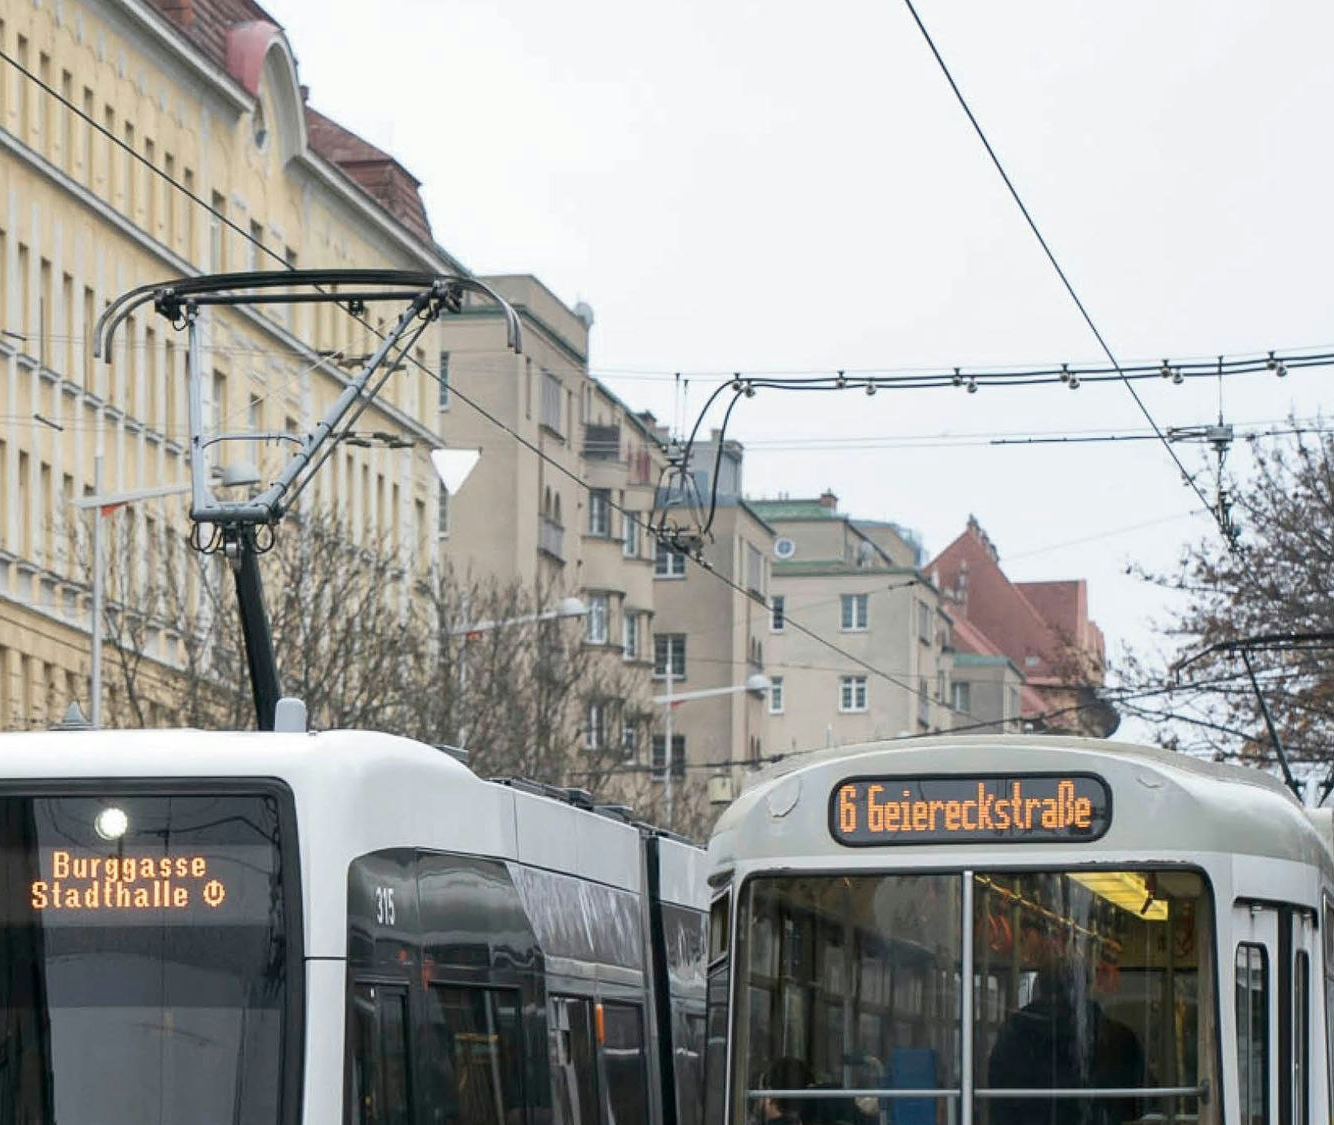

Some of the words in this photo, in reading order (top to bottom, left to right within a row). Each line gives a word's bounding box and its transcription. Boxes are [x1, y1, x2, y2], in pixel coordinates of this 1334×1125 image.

[839, 784, 857, 833] 6
[867, 779, 1093, 833] Geiereckstraße
[52, 850, 207, 883] Burggasse
[31, 879, 189, 910] Stadthalle
[375, 885, 396, 927] 315
